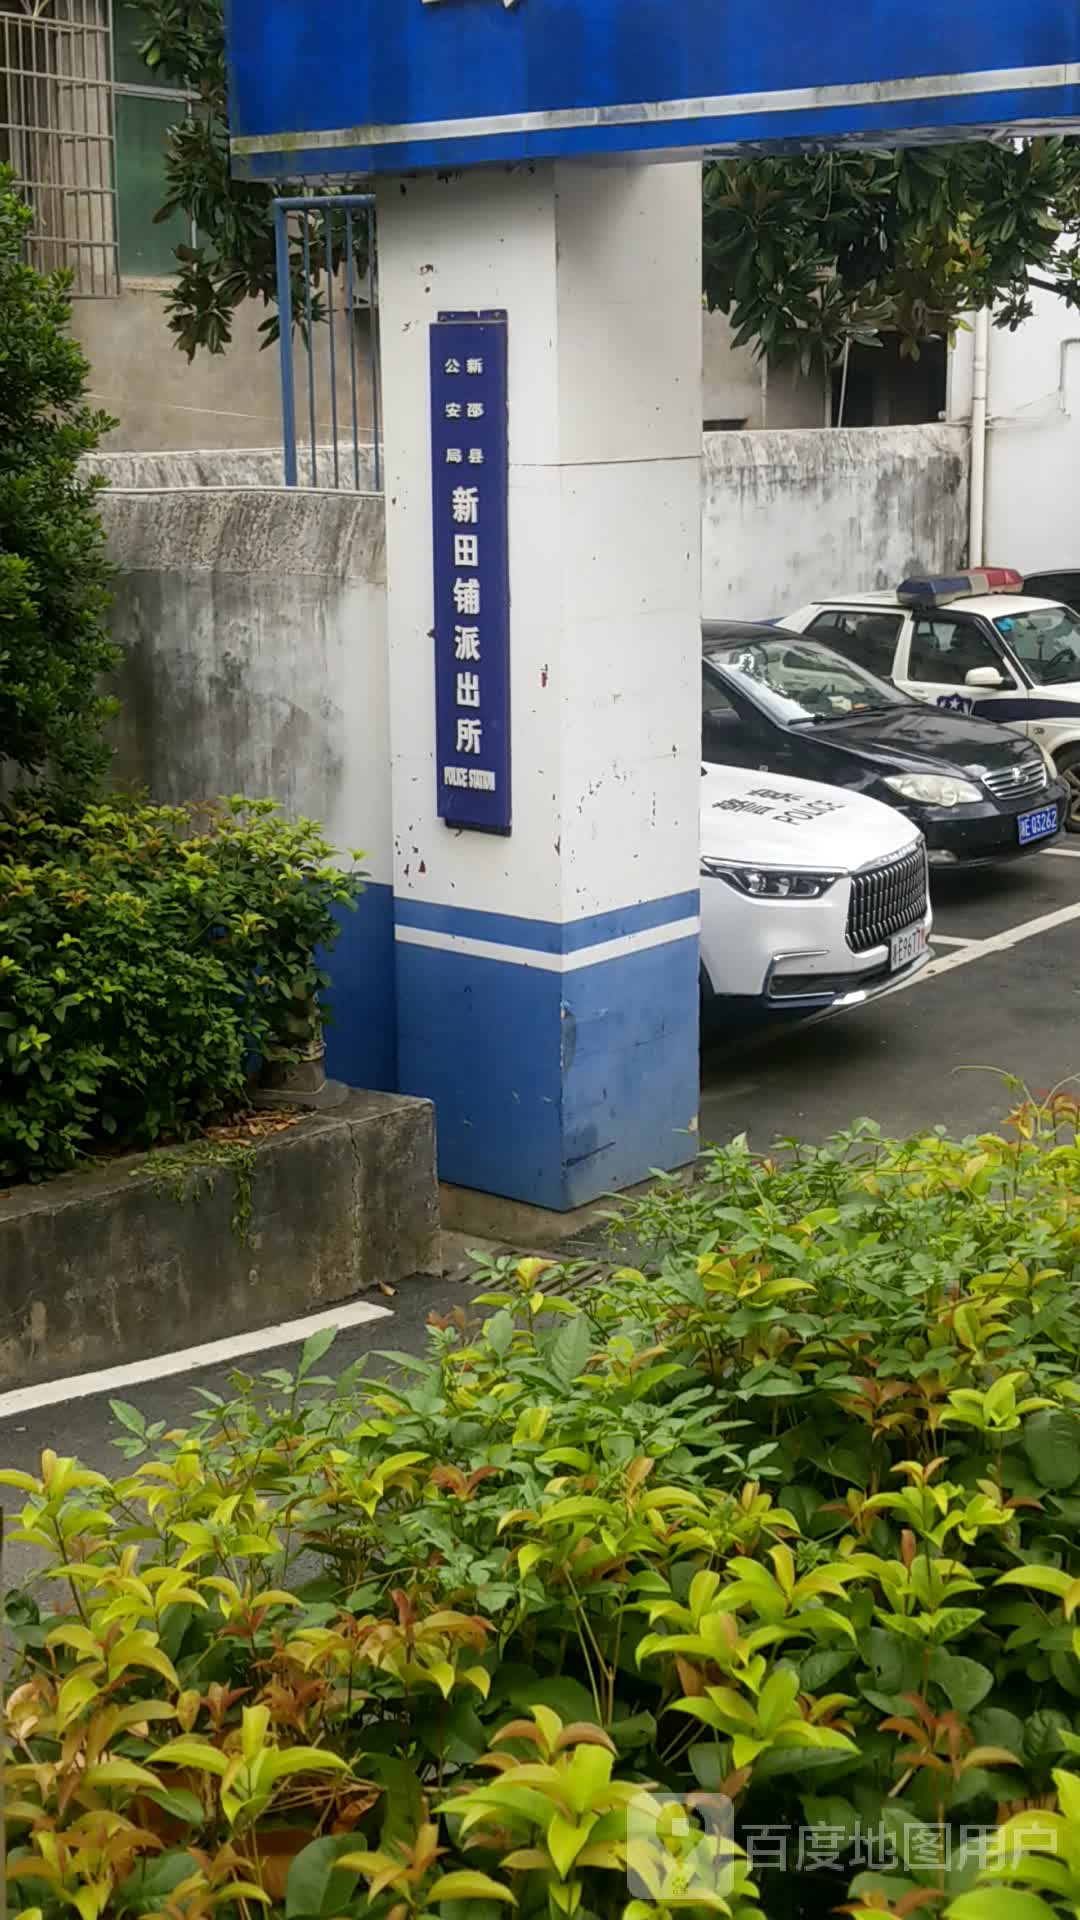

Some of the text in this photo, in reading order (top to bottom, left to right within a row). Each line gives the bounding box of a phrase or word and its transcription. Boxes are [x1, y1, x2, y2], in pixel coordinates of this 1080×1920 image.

[445, 358, 462, 464] 公安局
[466, 358, 484, 464] 新邵县
[452, 486, 482, 754] 新田铺派出所
[772, 799, 846, 826] POLICE
[892, 928, 925, 966] E9677
